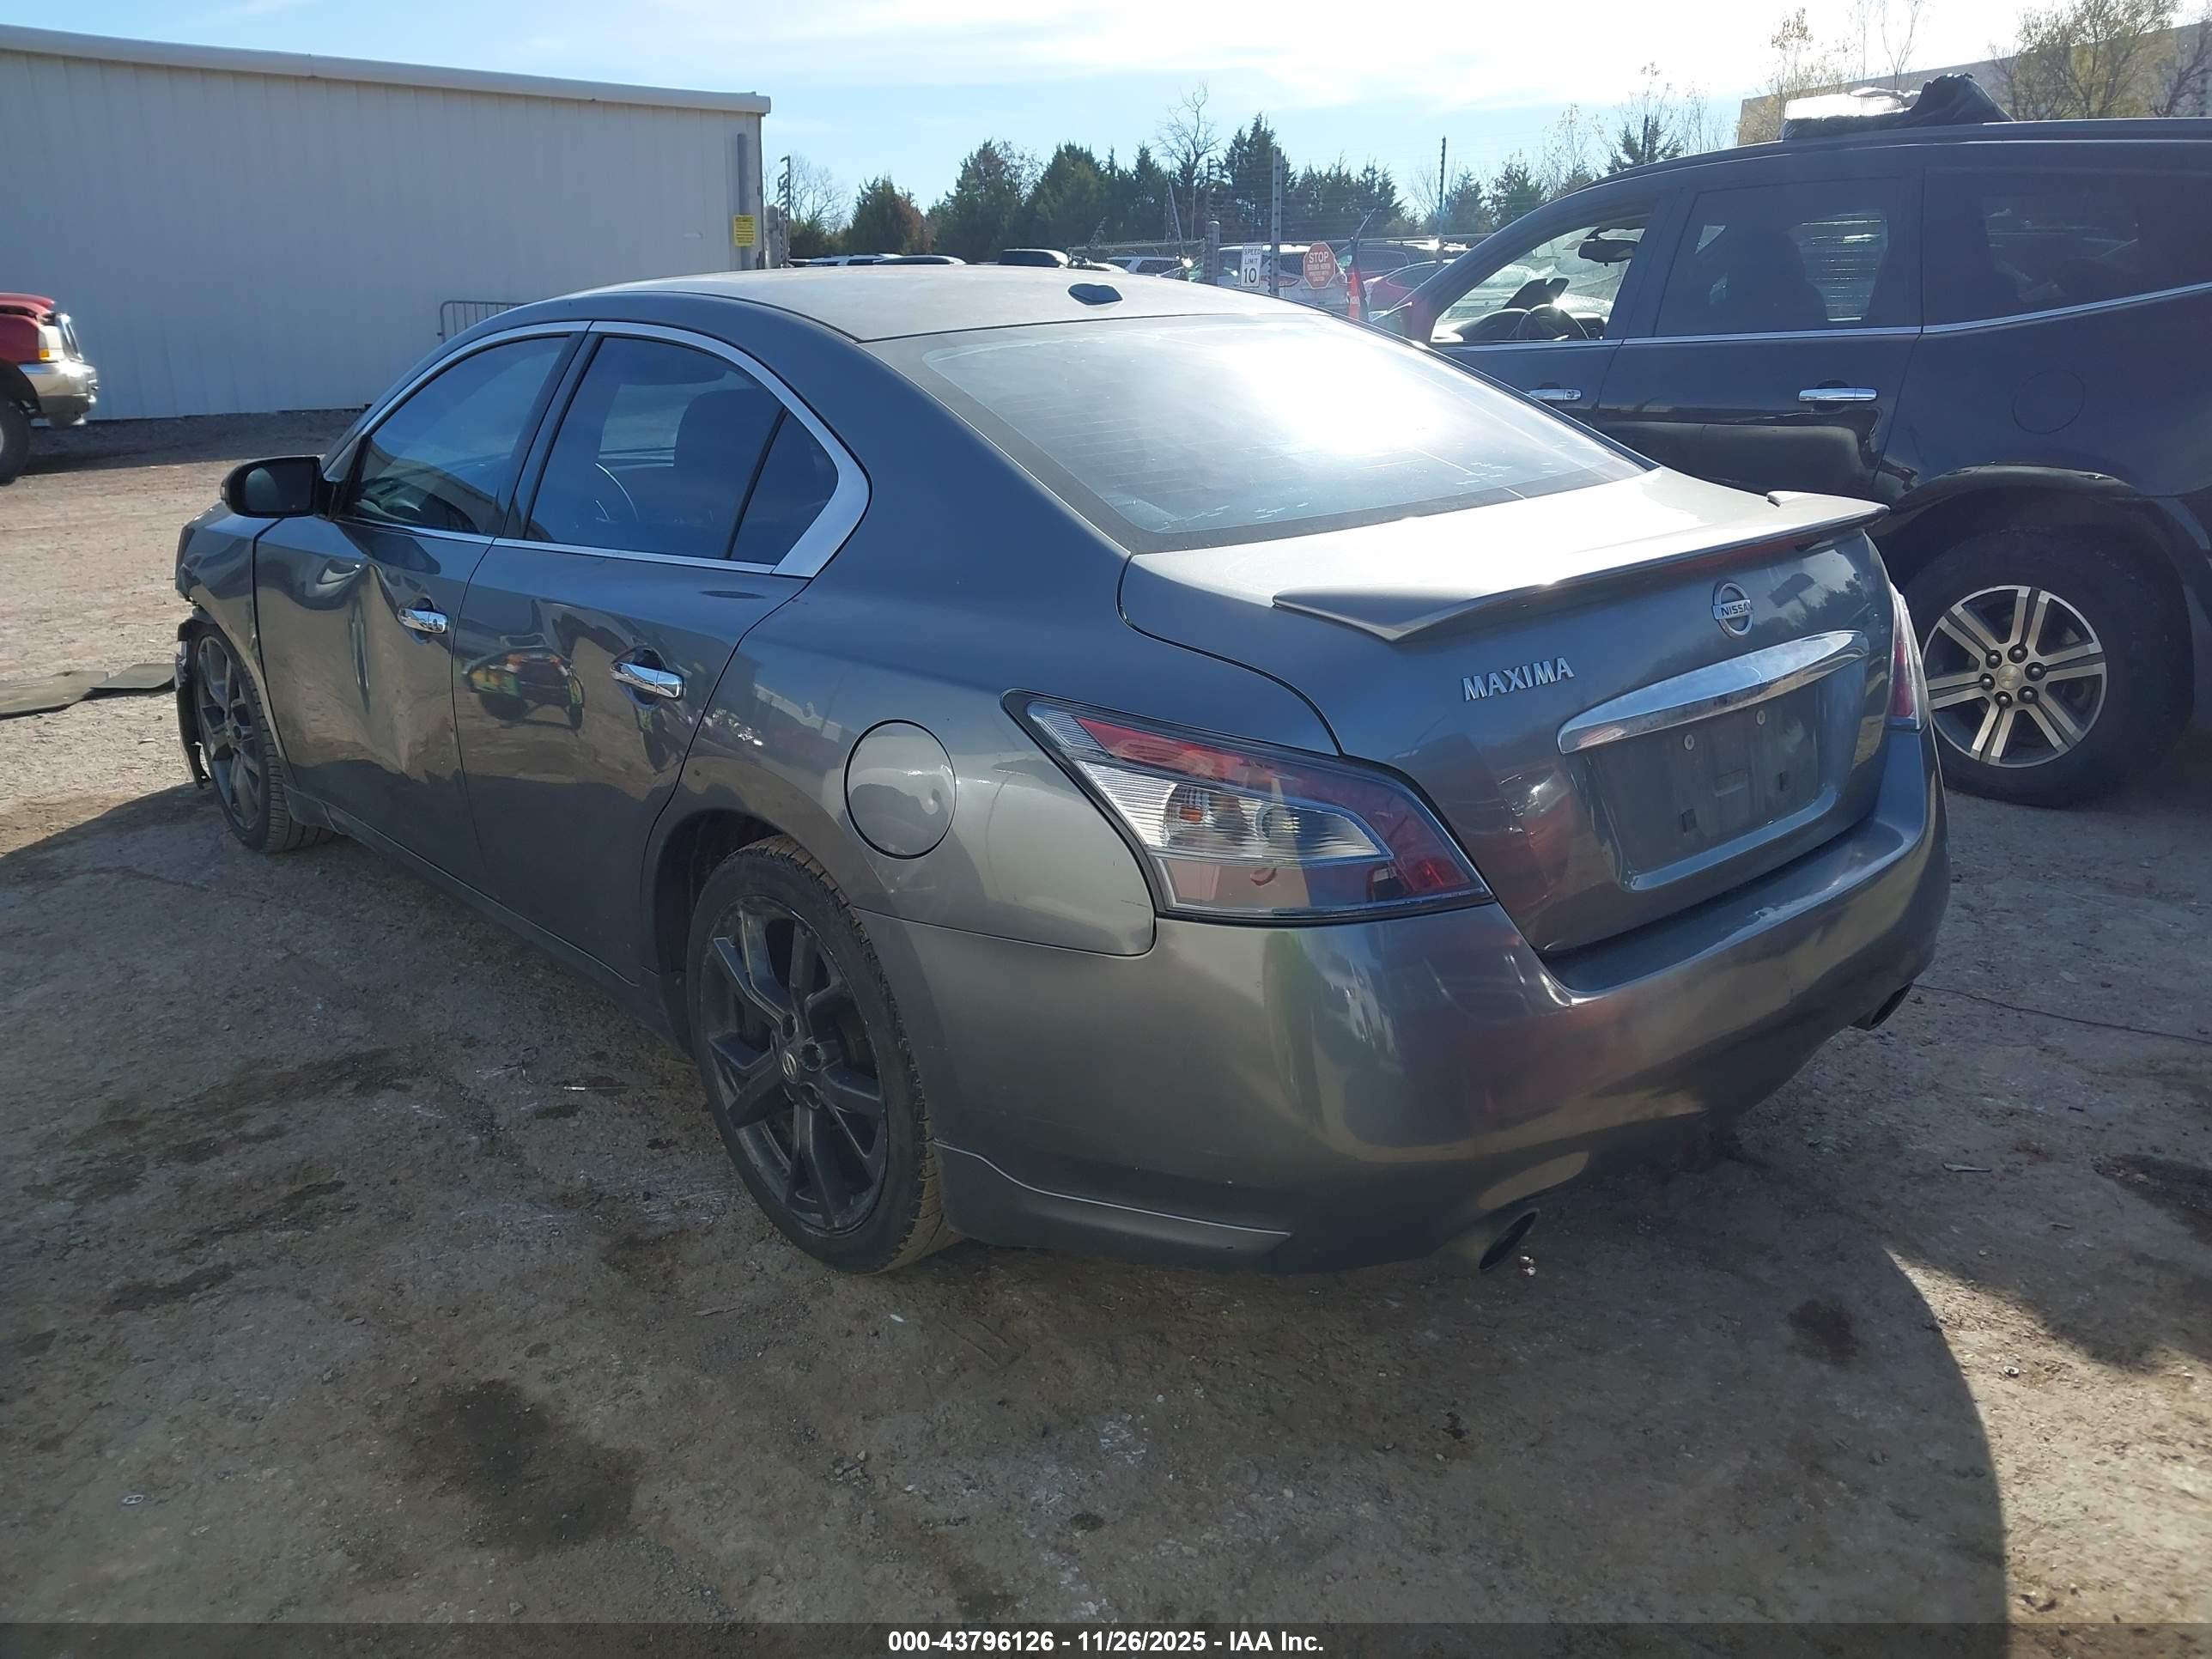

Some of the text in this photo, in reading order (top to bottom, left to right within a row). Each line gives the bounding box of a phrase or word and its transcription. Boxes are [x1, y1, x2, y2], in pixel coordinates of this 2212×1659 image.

[1309, 251, 1329, 264] STOP
[1244, 267, 1257, 283] 10
[1462, 657, 1574, 702] MAXIMA
